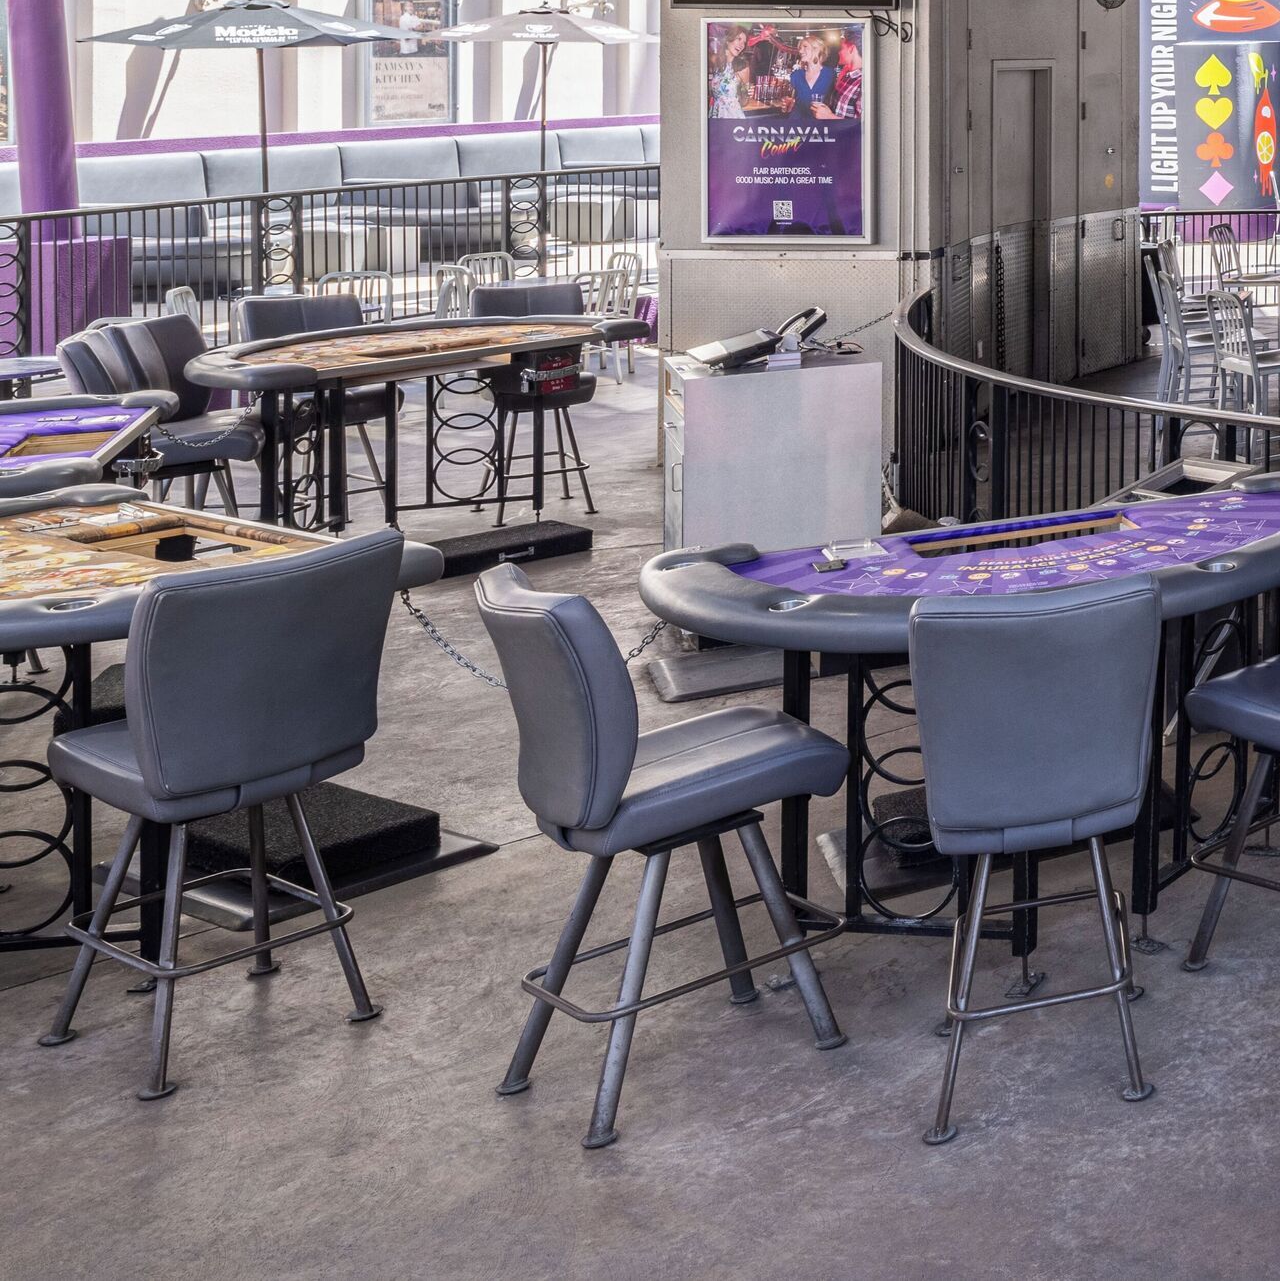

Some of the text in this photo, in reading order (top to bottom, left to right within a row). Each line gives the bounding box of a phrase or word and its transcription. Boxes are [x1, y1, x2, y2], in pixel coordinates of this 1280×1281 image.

[214, 25, 299, 38] Modelo
[375, 73, 421, 84] KITCHEN
[1150, 44, 1176, 100] YOUR
[1150, 102, 1177, 130] UP
[732, 125, 836, 142] CARNAVAL
[760, 136, 804, 159] Court
[1151, 133, 1179, 192] LIGHT
[753, 167, 812, 176] FLAIR BARTENDERS,
[735, 176, 833, 185] GOOD MUSIC AND A GREAT TIME
[957, 560, 1057, 571] INSURANCE
